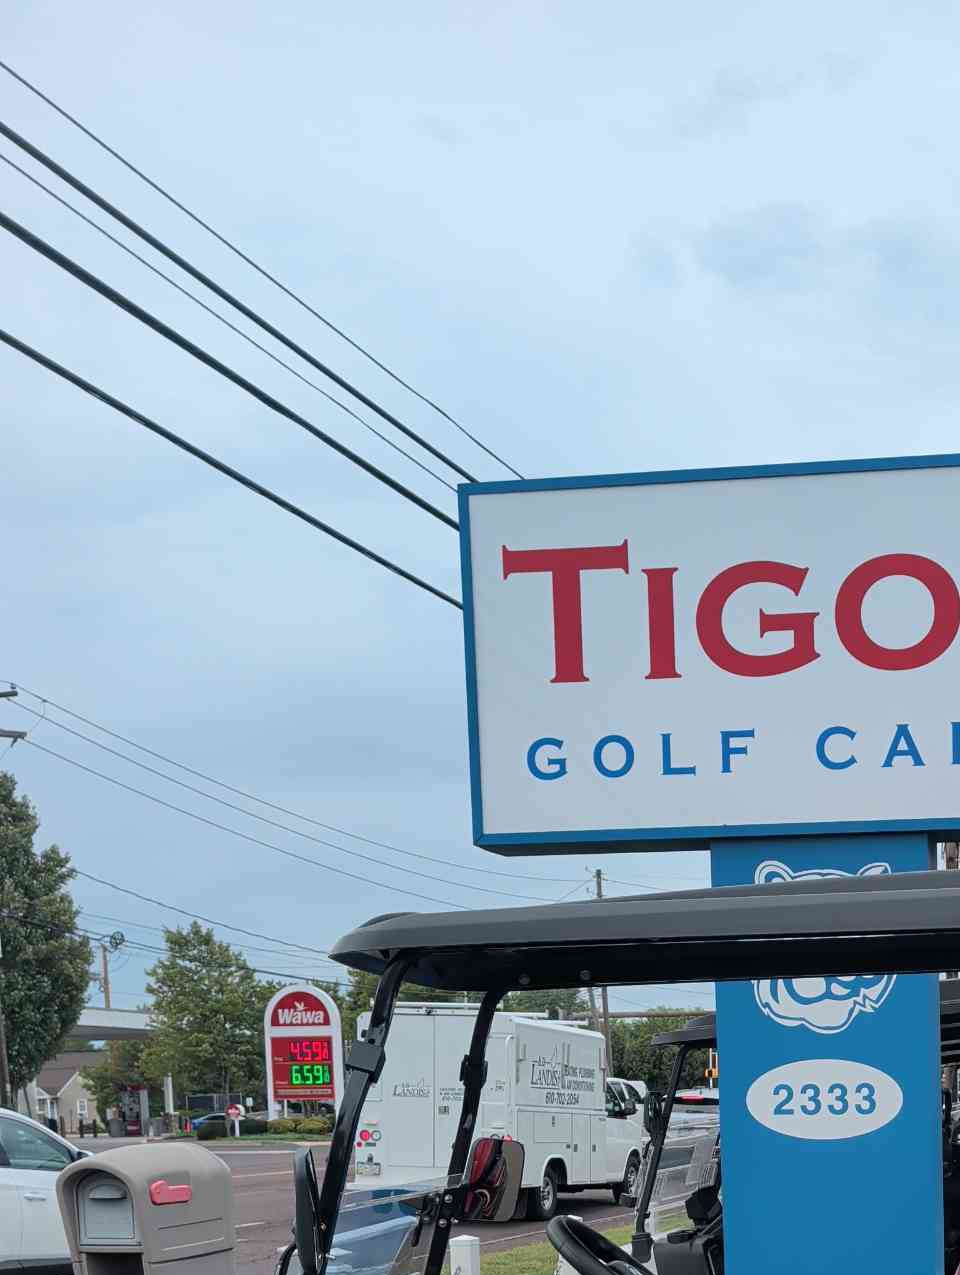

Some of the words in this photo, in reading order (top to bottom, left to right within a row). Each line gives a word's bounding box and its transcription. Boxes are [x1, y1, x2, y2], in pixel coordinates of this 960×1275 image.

[526, 728, 755, 781] GOLF
[277, 1009, 324, 1024] Wawa
[291, 1065, 323, 1085] 6.59
[772, 1082, 877, 1116] 2333
